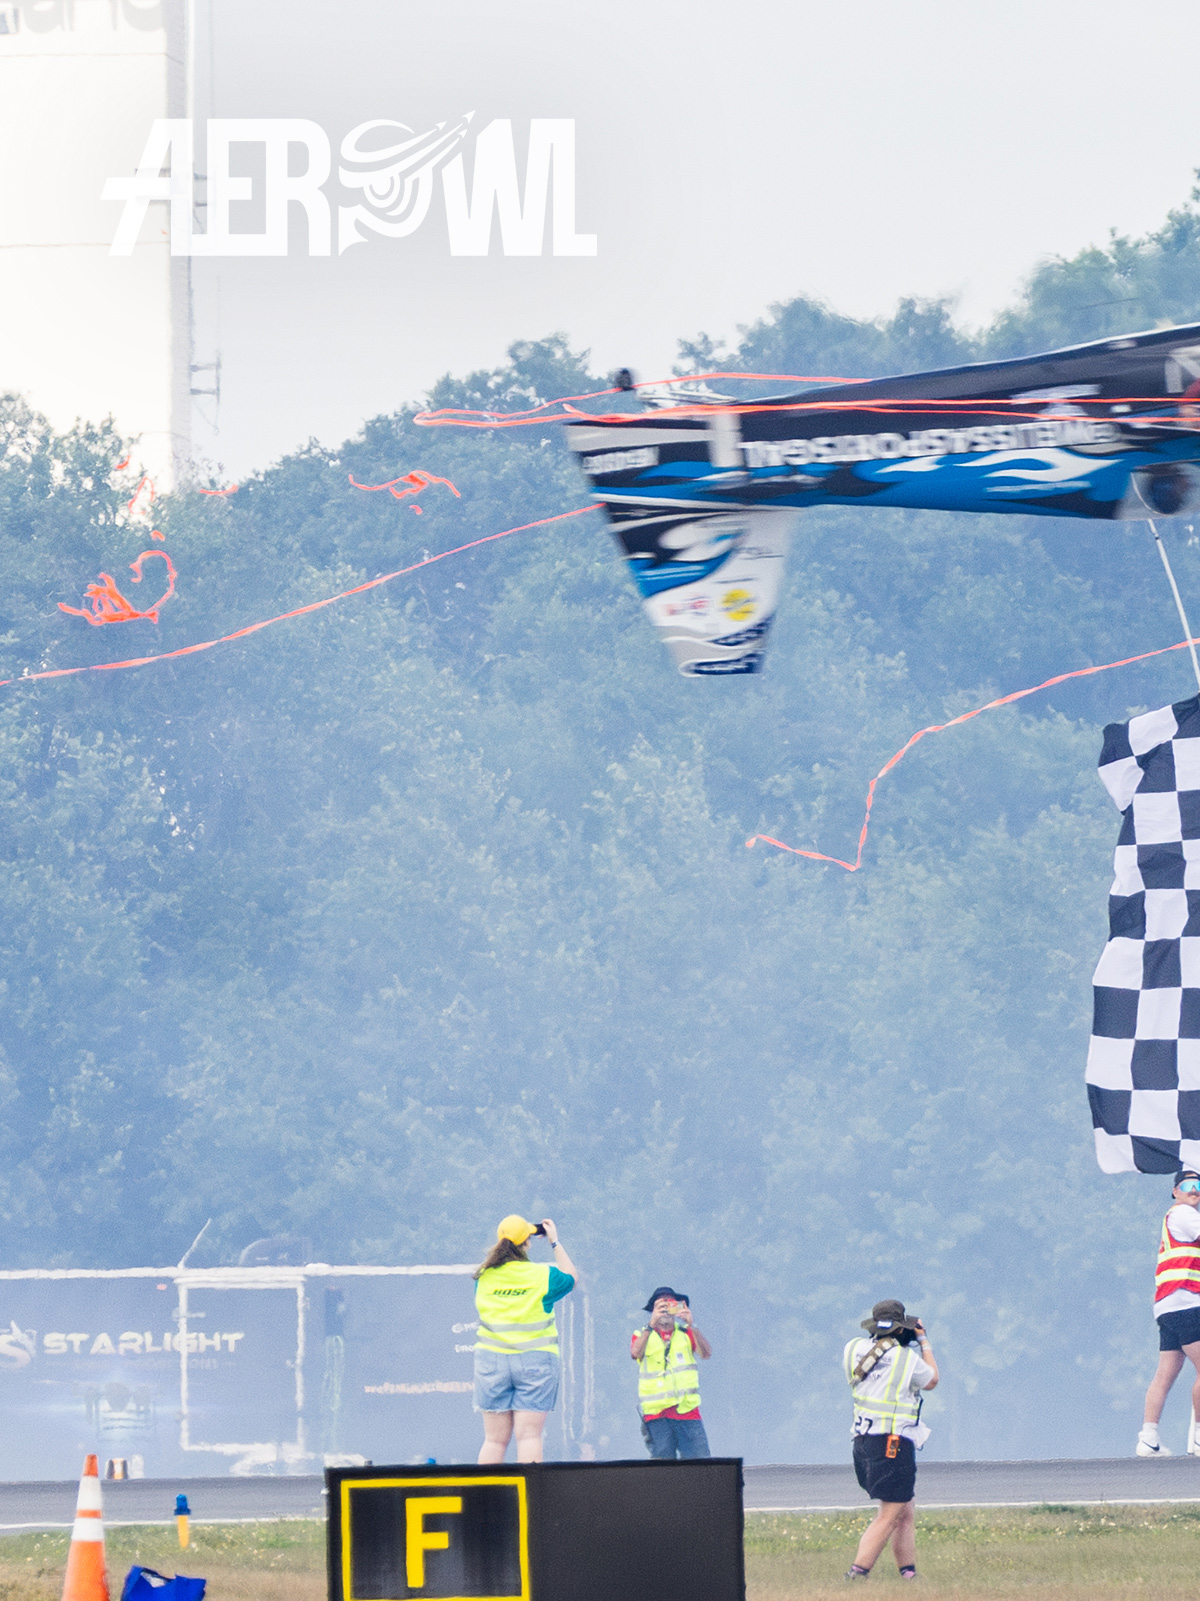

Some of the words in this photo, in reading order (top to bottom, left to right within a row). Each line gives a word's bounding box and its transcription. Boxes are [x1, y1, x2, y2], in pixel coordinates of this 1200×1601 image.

[489, 1287, 533, 1296] BOSE
[43, 1331, 245, 1355] STARLIGHT
[405, 1496, 462, 1588] F
